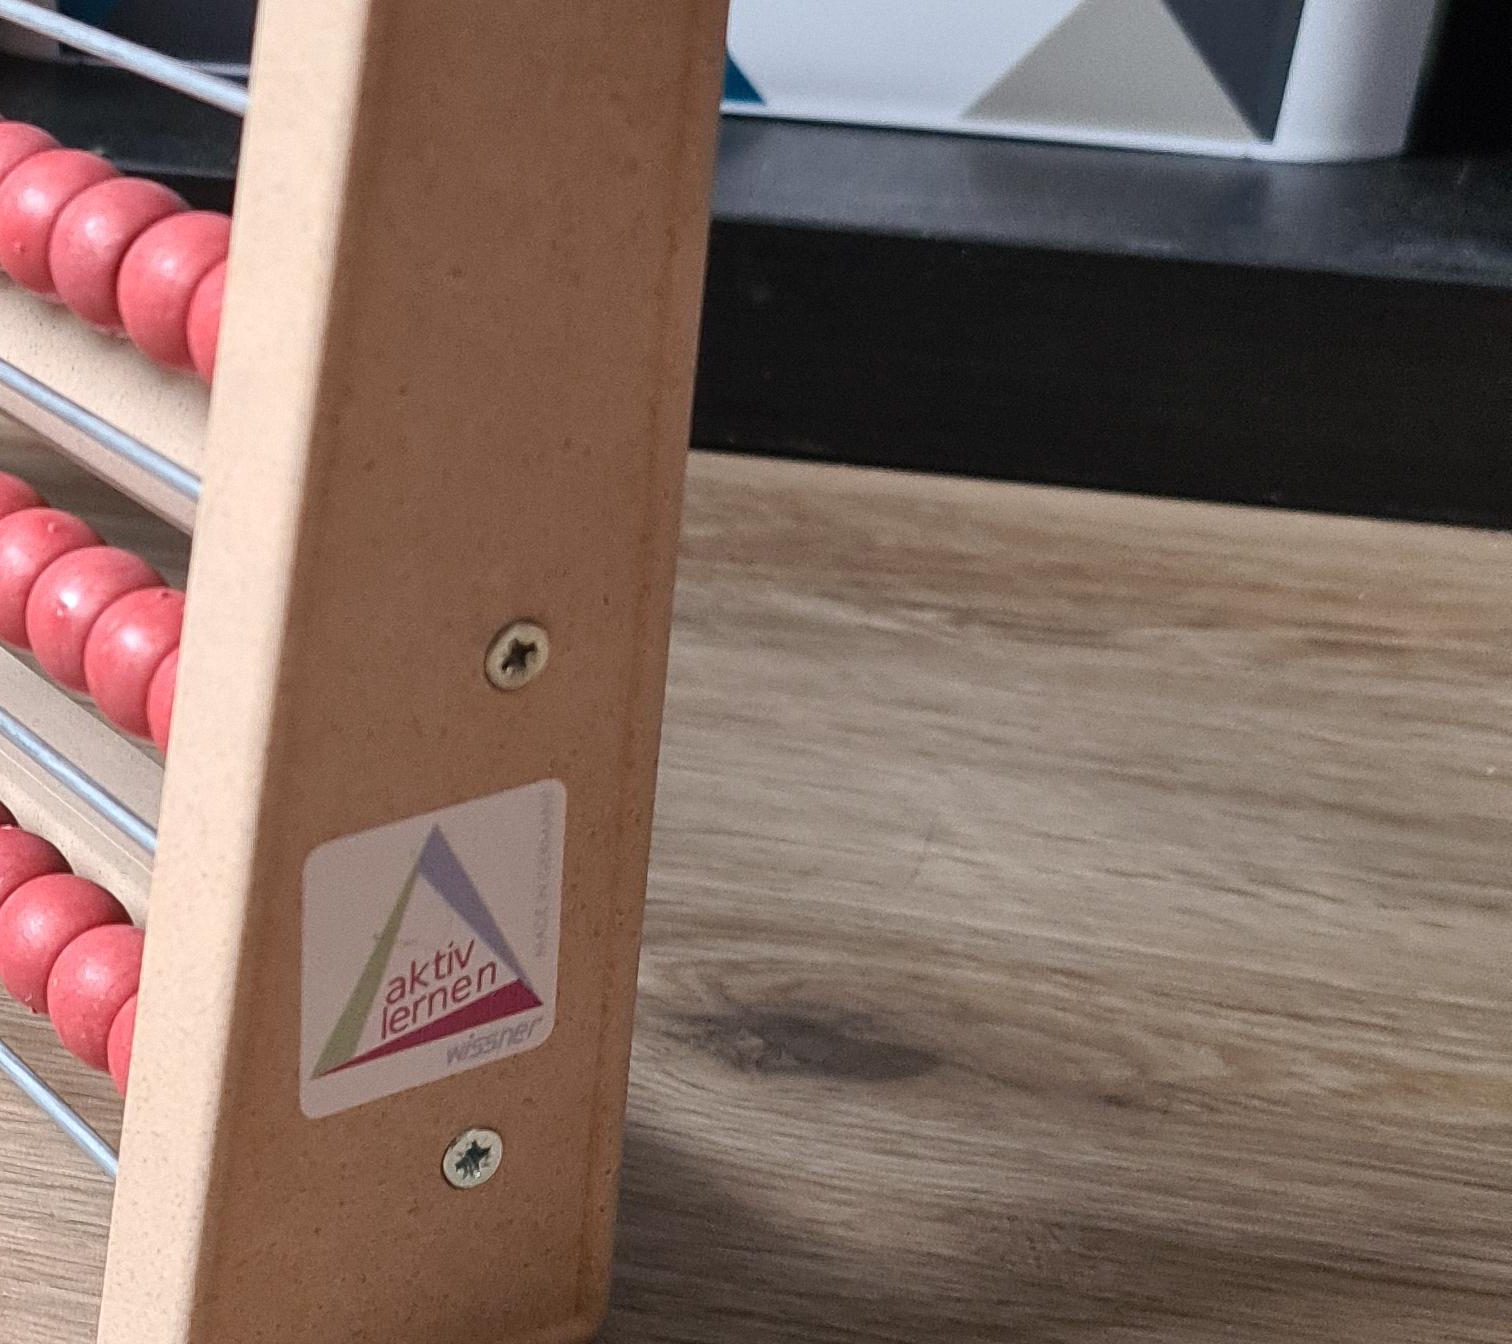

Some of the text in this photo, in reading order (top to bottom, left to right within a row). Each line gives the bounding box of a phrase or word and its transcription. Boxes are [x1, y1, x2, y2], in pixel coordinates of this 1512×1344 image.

[381, 960, 498, 1040] lernen
[387, 939, 475, 1005] aktiv
[446, 1015, 544, 1065] wissner
